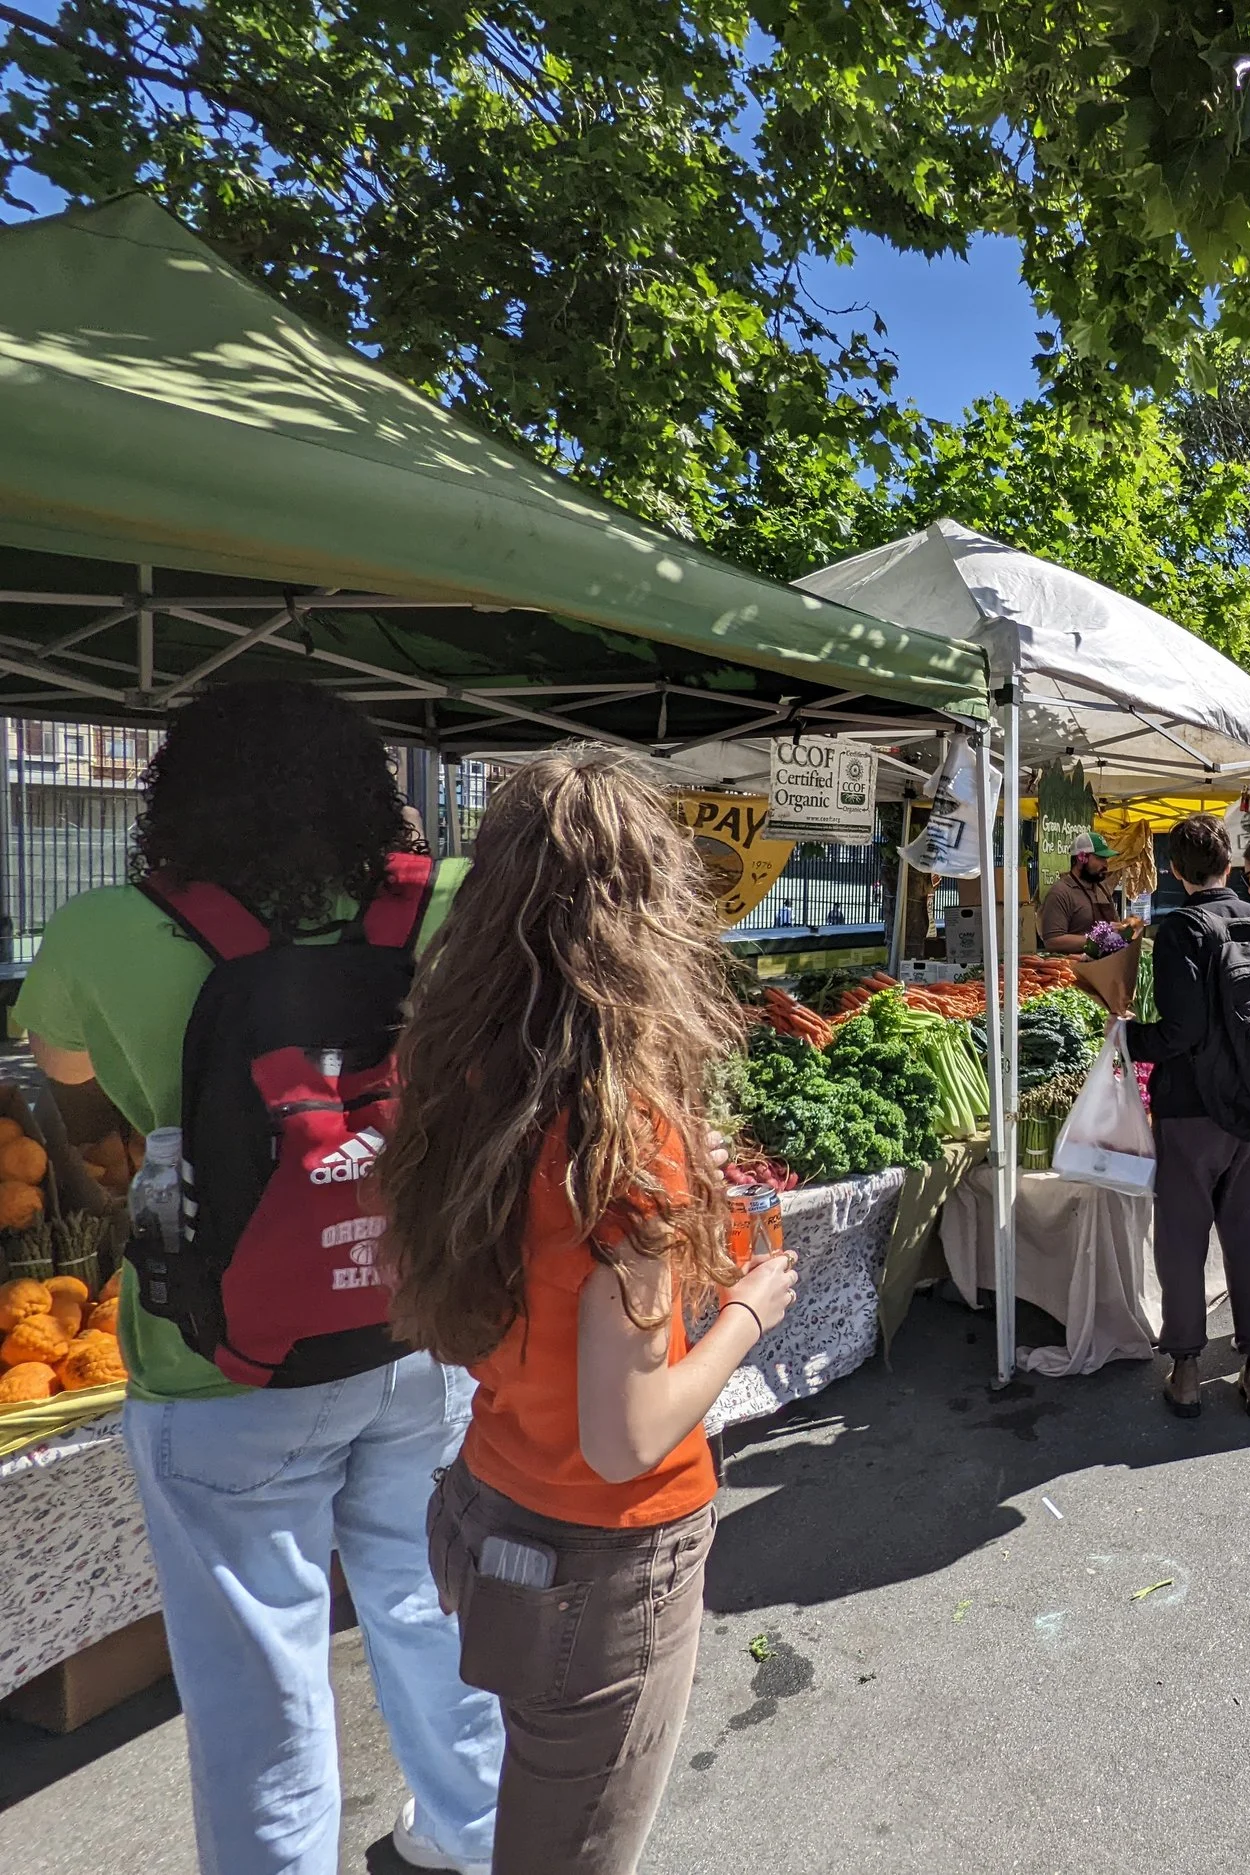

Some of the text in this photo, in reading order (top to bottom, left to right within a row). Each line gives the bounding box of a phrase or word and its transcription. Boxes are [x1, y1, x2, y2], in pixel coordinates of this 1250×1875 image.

[778, 742, 836, 768] CCOF
[776, 769, 834, 789] Certified
[842, 781, 866, 793] CCOF
[775, 789, 830, 813] Organic
[1042, 814, 1061, 833] Green
[1042, 838, 1054, 853] One
[752, 860, 773, 870] 1976
[1041, 868, 1054, 885] Two
